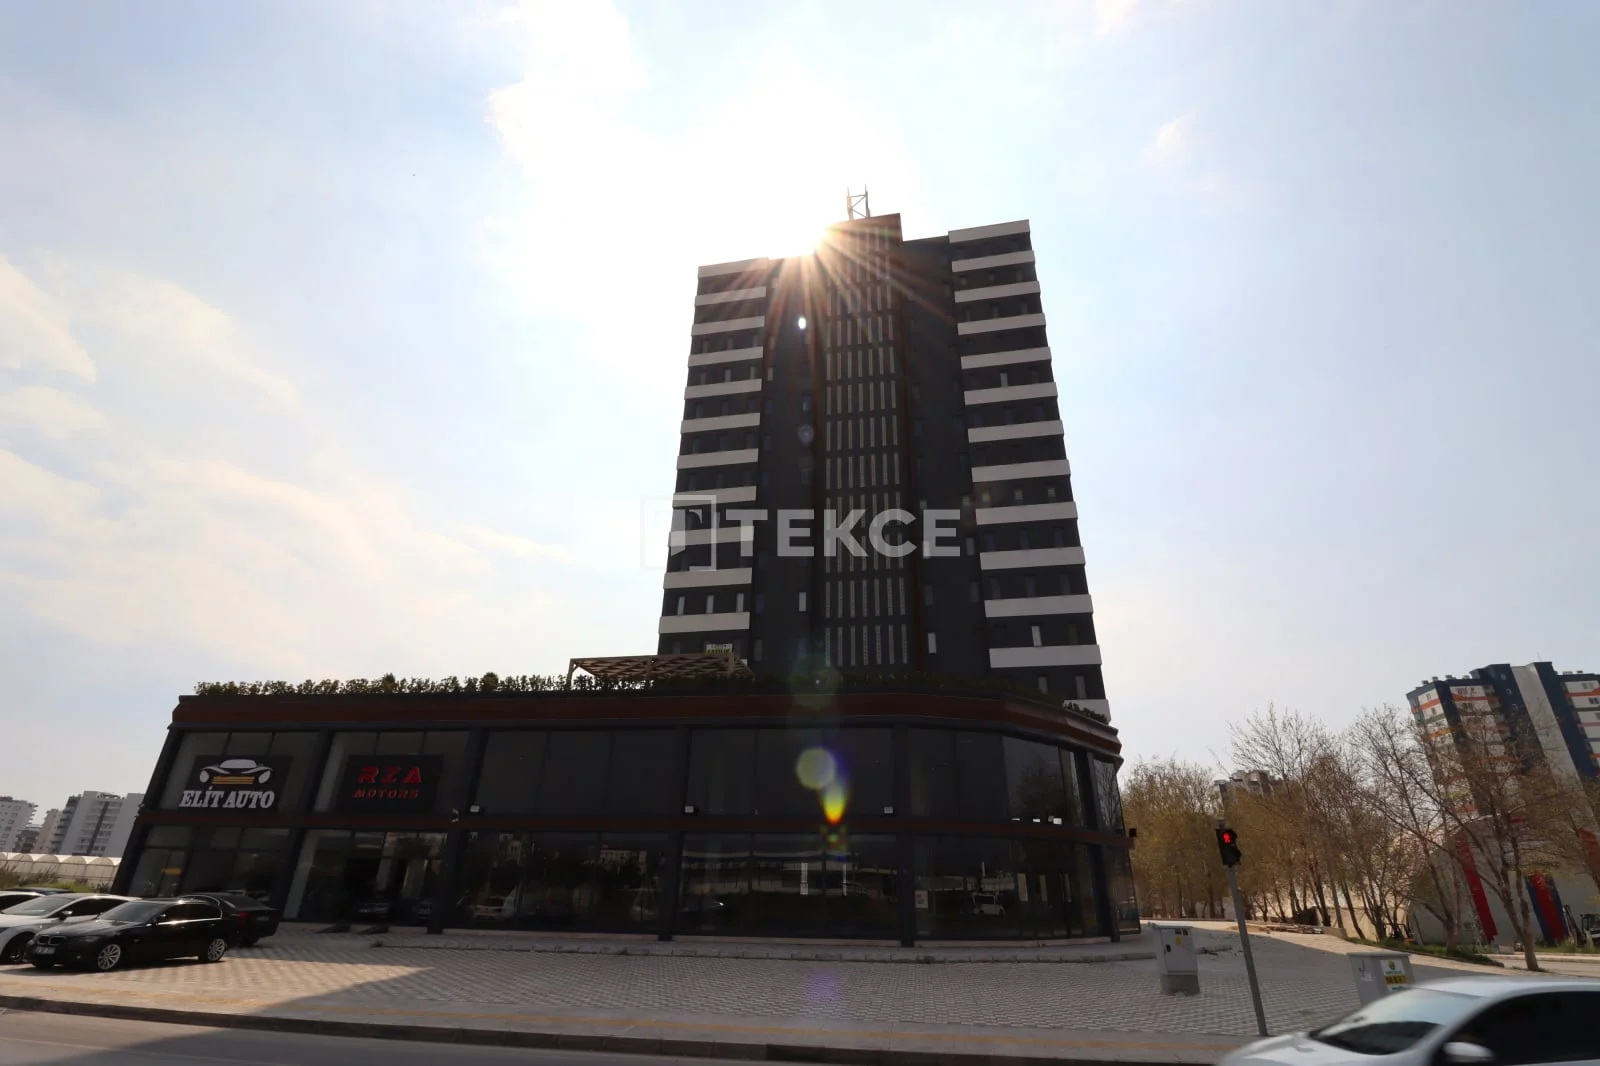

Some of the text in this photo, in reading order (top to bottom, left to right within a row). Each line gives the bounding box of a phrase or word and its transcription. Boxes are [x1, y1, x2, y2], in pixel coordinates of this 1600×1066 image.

[357, 766, 422, 784] RZA
[222, 790, 275, 809] AUTO
[353, 788, 419, 799] MOTORS
